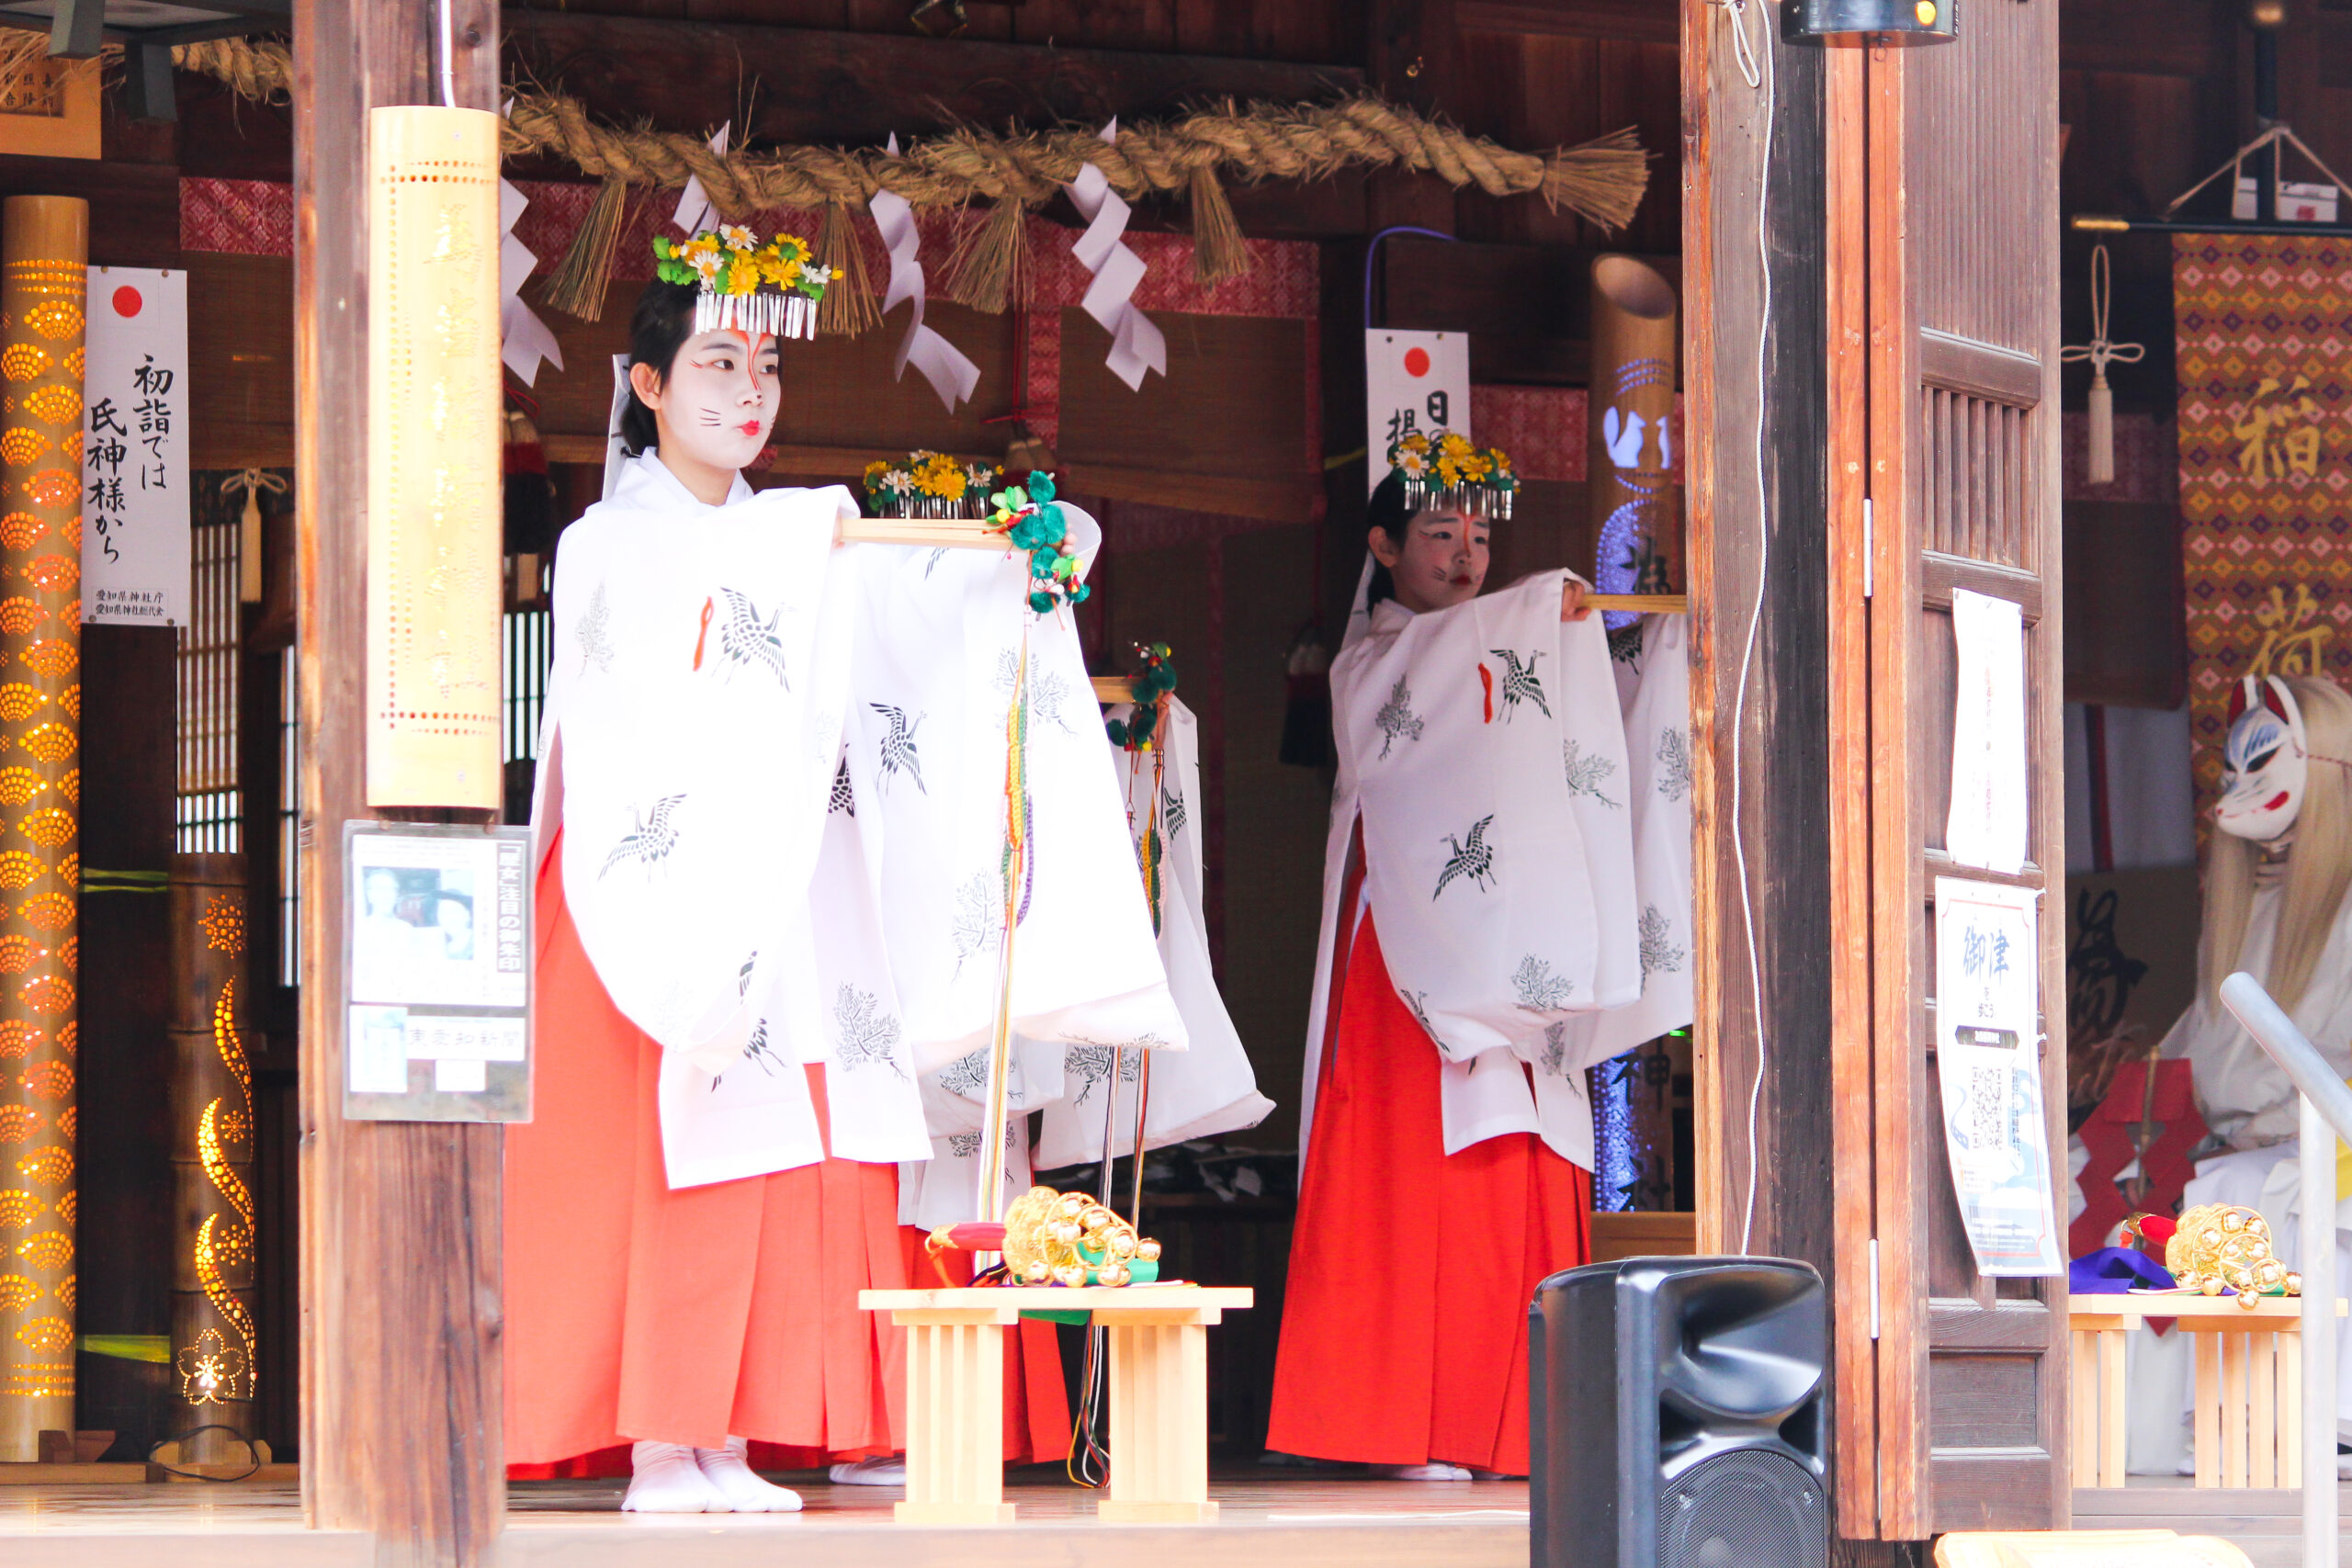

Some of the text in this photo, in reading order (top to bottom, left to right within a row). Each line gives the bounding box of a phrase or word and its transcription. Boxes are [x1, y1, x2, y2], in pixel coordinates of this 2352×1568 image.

[87, 397, 128, 563] 氏神様から
[133, 354, 174, 491] 初詣では
[96, 588, 164, 603] 愛知県神社庁
[2234, 375, 2335, 679] 稲荷
[1963, 925, 2010, 986] 御津
